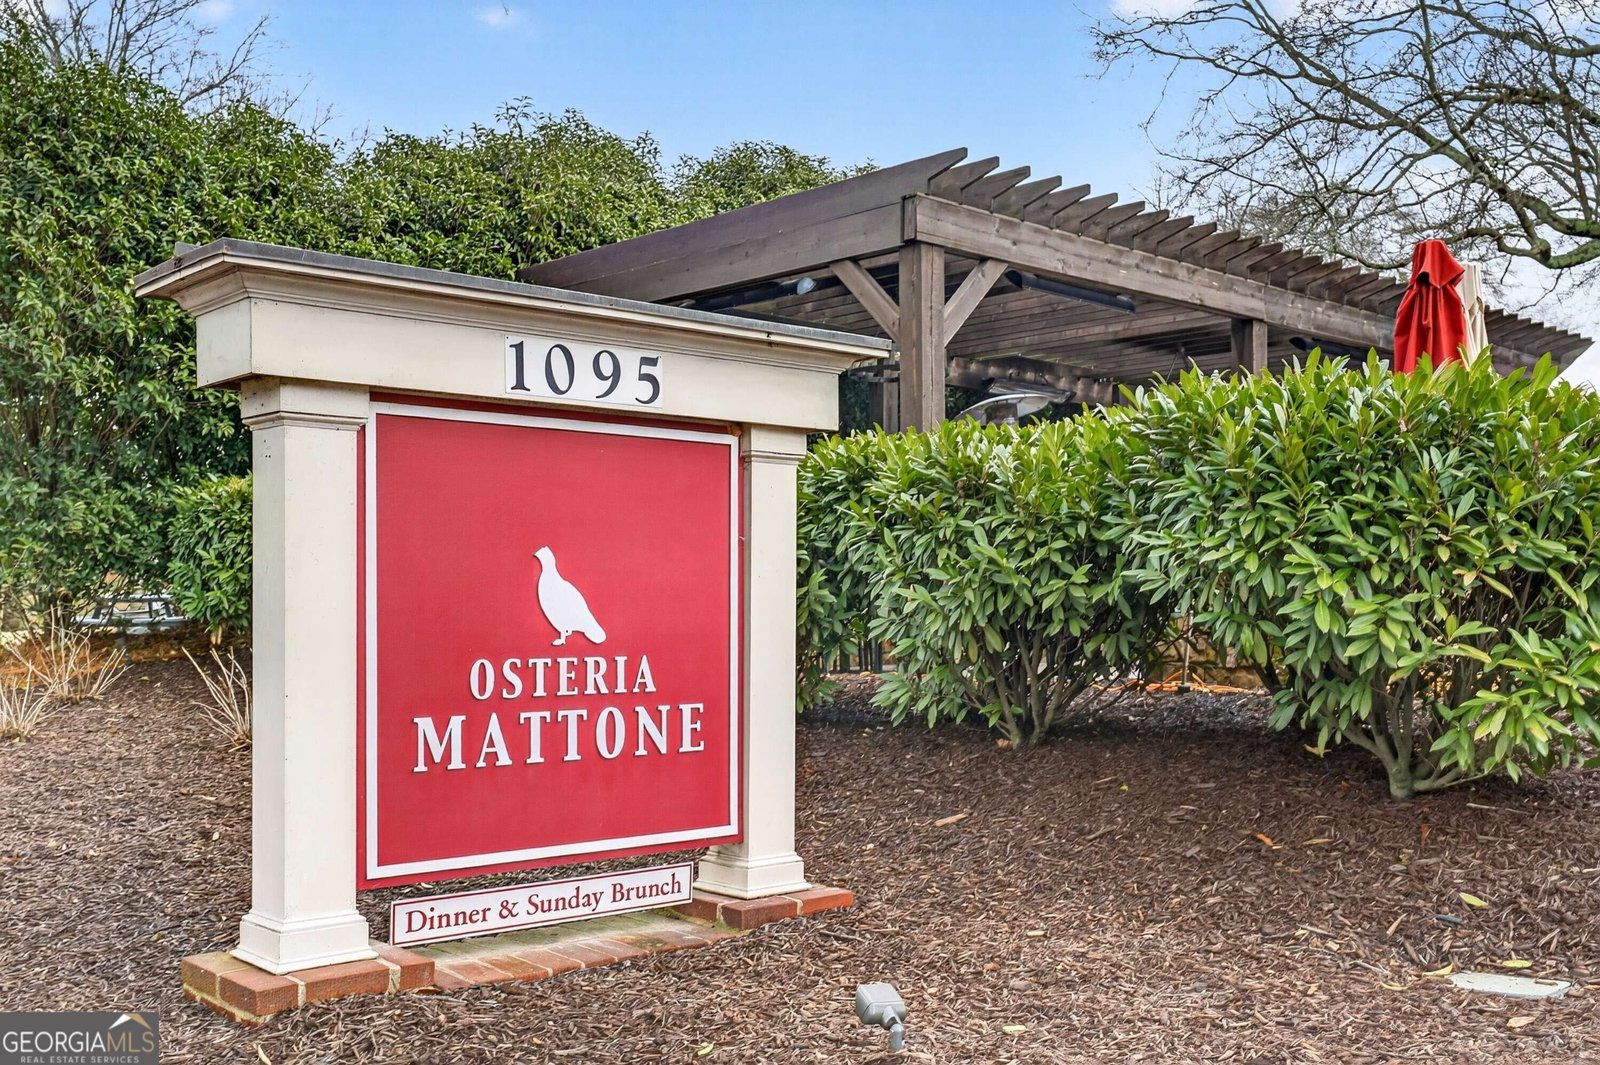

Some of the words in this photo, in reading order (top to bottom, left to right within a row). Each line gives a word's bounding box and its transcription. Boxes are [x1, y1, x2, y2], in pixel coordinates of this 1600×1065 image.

[509, 340, 661, 404] 1095
[469, 654, 656, 700] OSTERIA
[413, 702, 705, 773] MATTONE
[405, 906, 491, 934] Dinner
[498, 899, 520, 920] &
[526, 886, 604, 915] Sunday
[610, 873, 682, 903] Brunch
